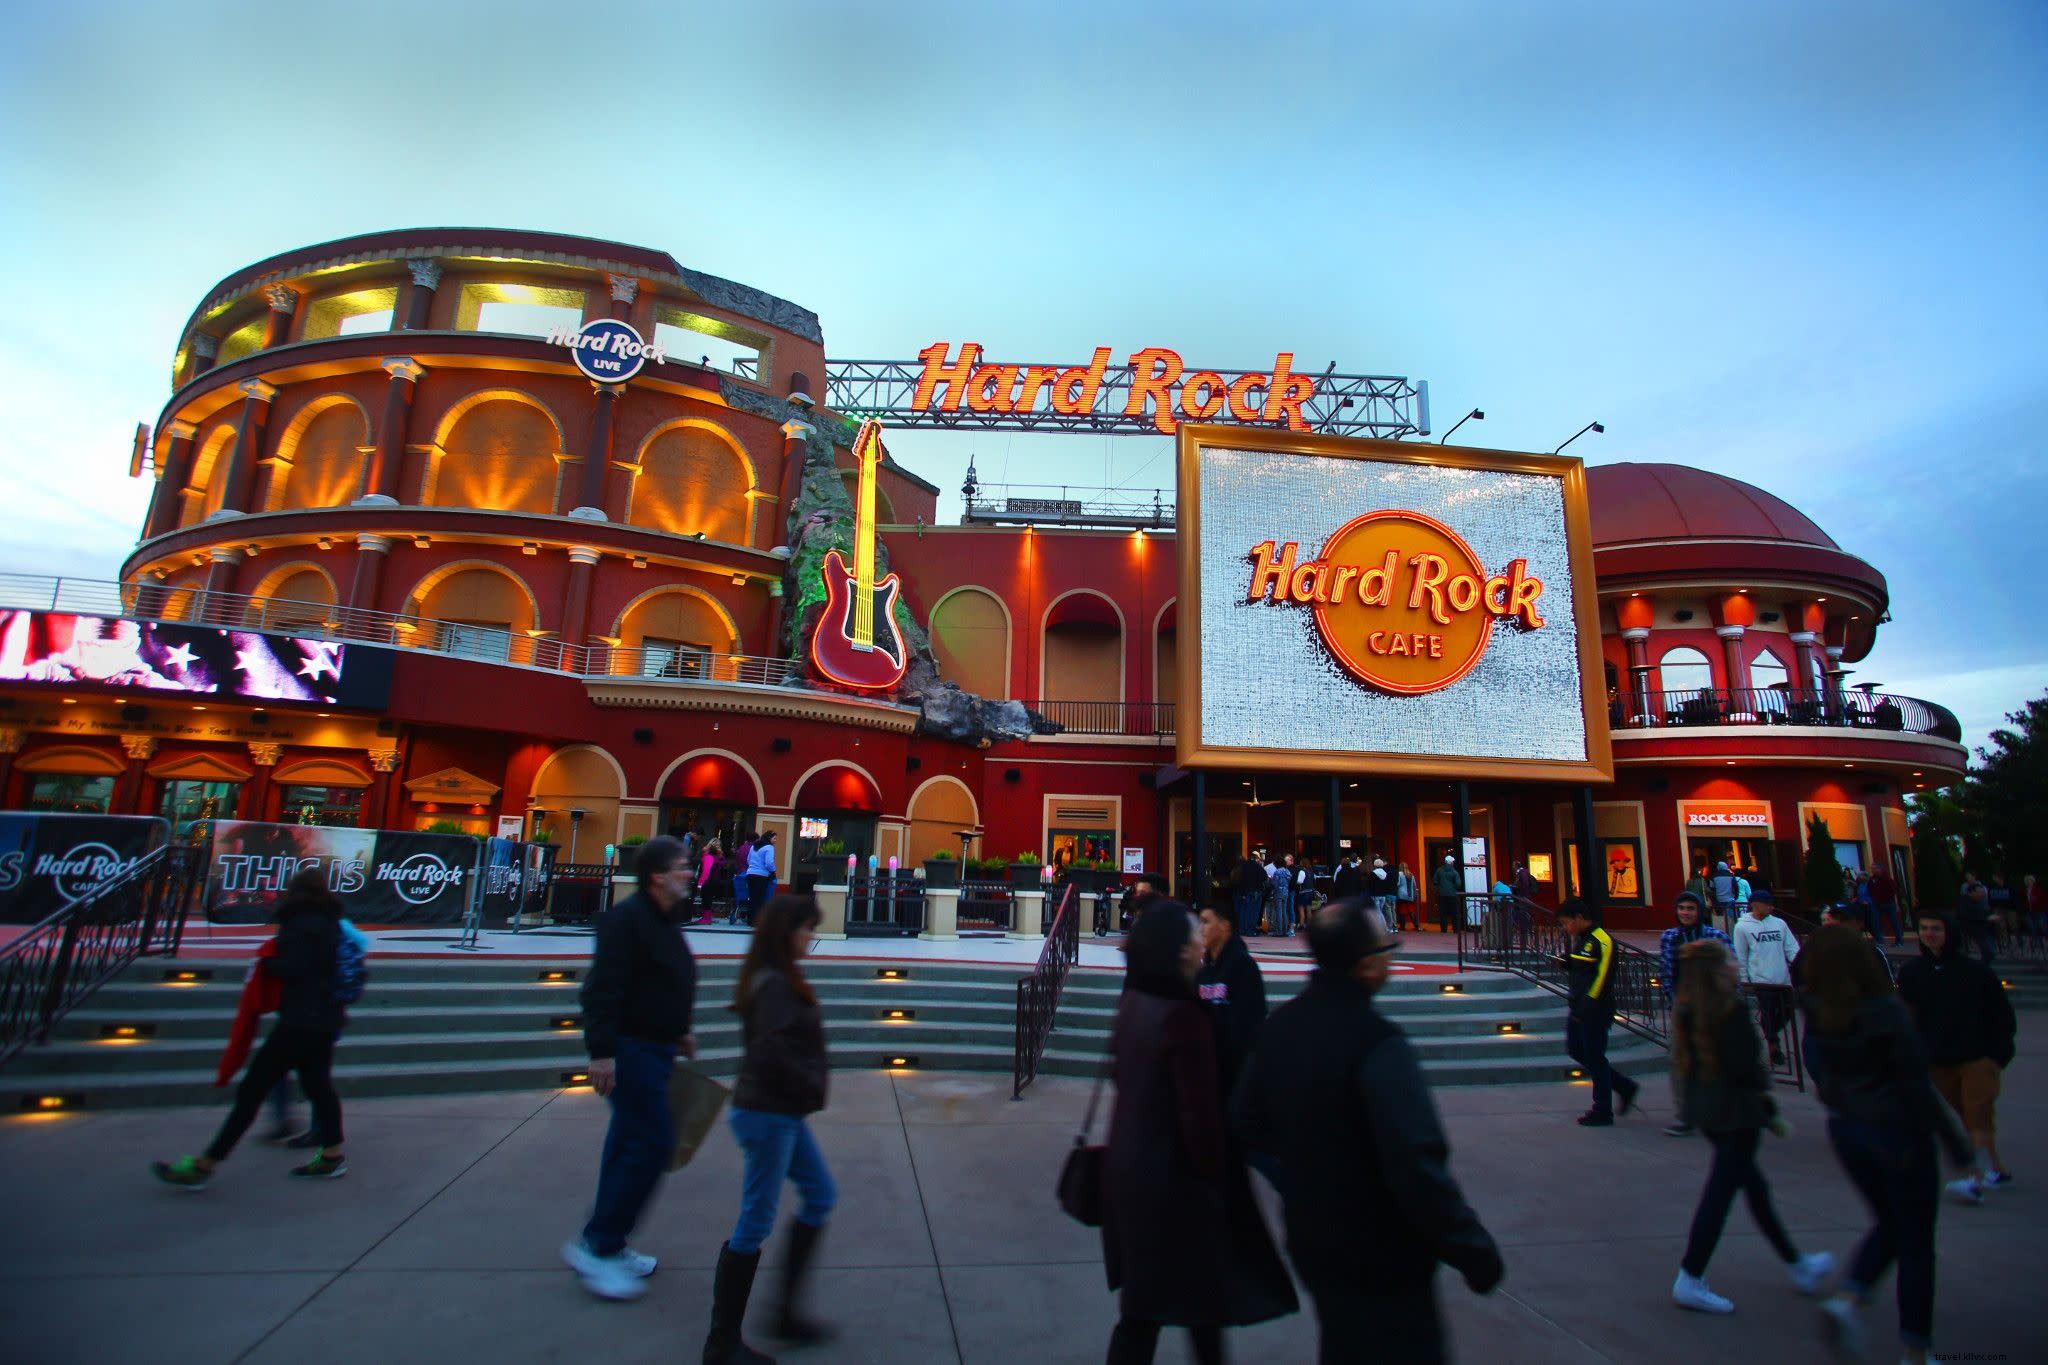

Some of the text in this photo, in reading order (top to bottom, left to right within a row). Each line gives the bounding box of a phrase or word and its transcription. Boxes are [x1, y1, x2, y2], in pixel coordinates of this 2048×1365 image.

[546, 326, 667, 365] Hard Rock
[594, 359, 621, 372] LIVE
[910, 342, 1315, 434] Hard Rock
[1250, 540, 1545, 629] Hard Rock
[1368, 631, 1443, 658] CAFE
[1689, 814, 1767, 825] ROCK SHOP
[34, 854, 91, 875] Hard
[328, 859, 366, 893] IS
[376, 862, 423, 880] Hard
[422, 864, 463, 885] Rock
[72, 882, 101, 892] CAF
[1751, 931, 1782, 942] VANS
